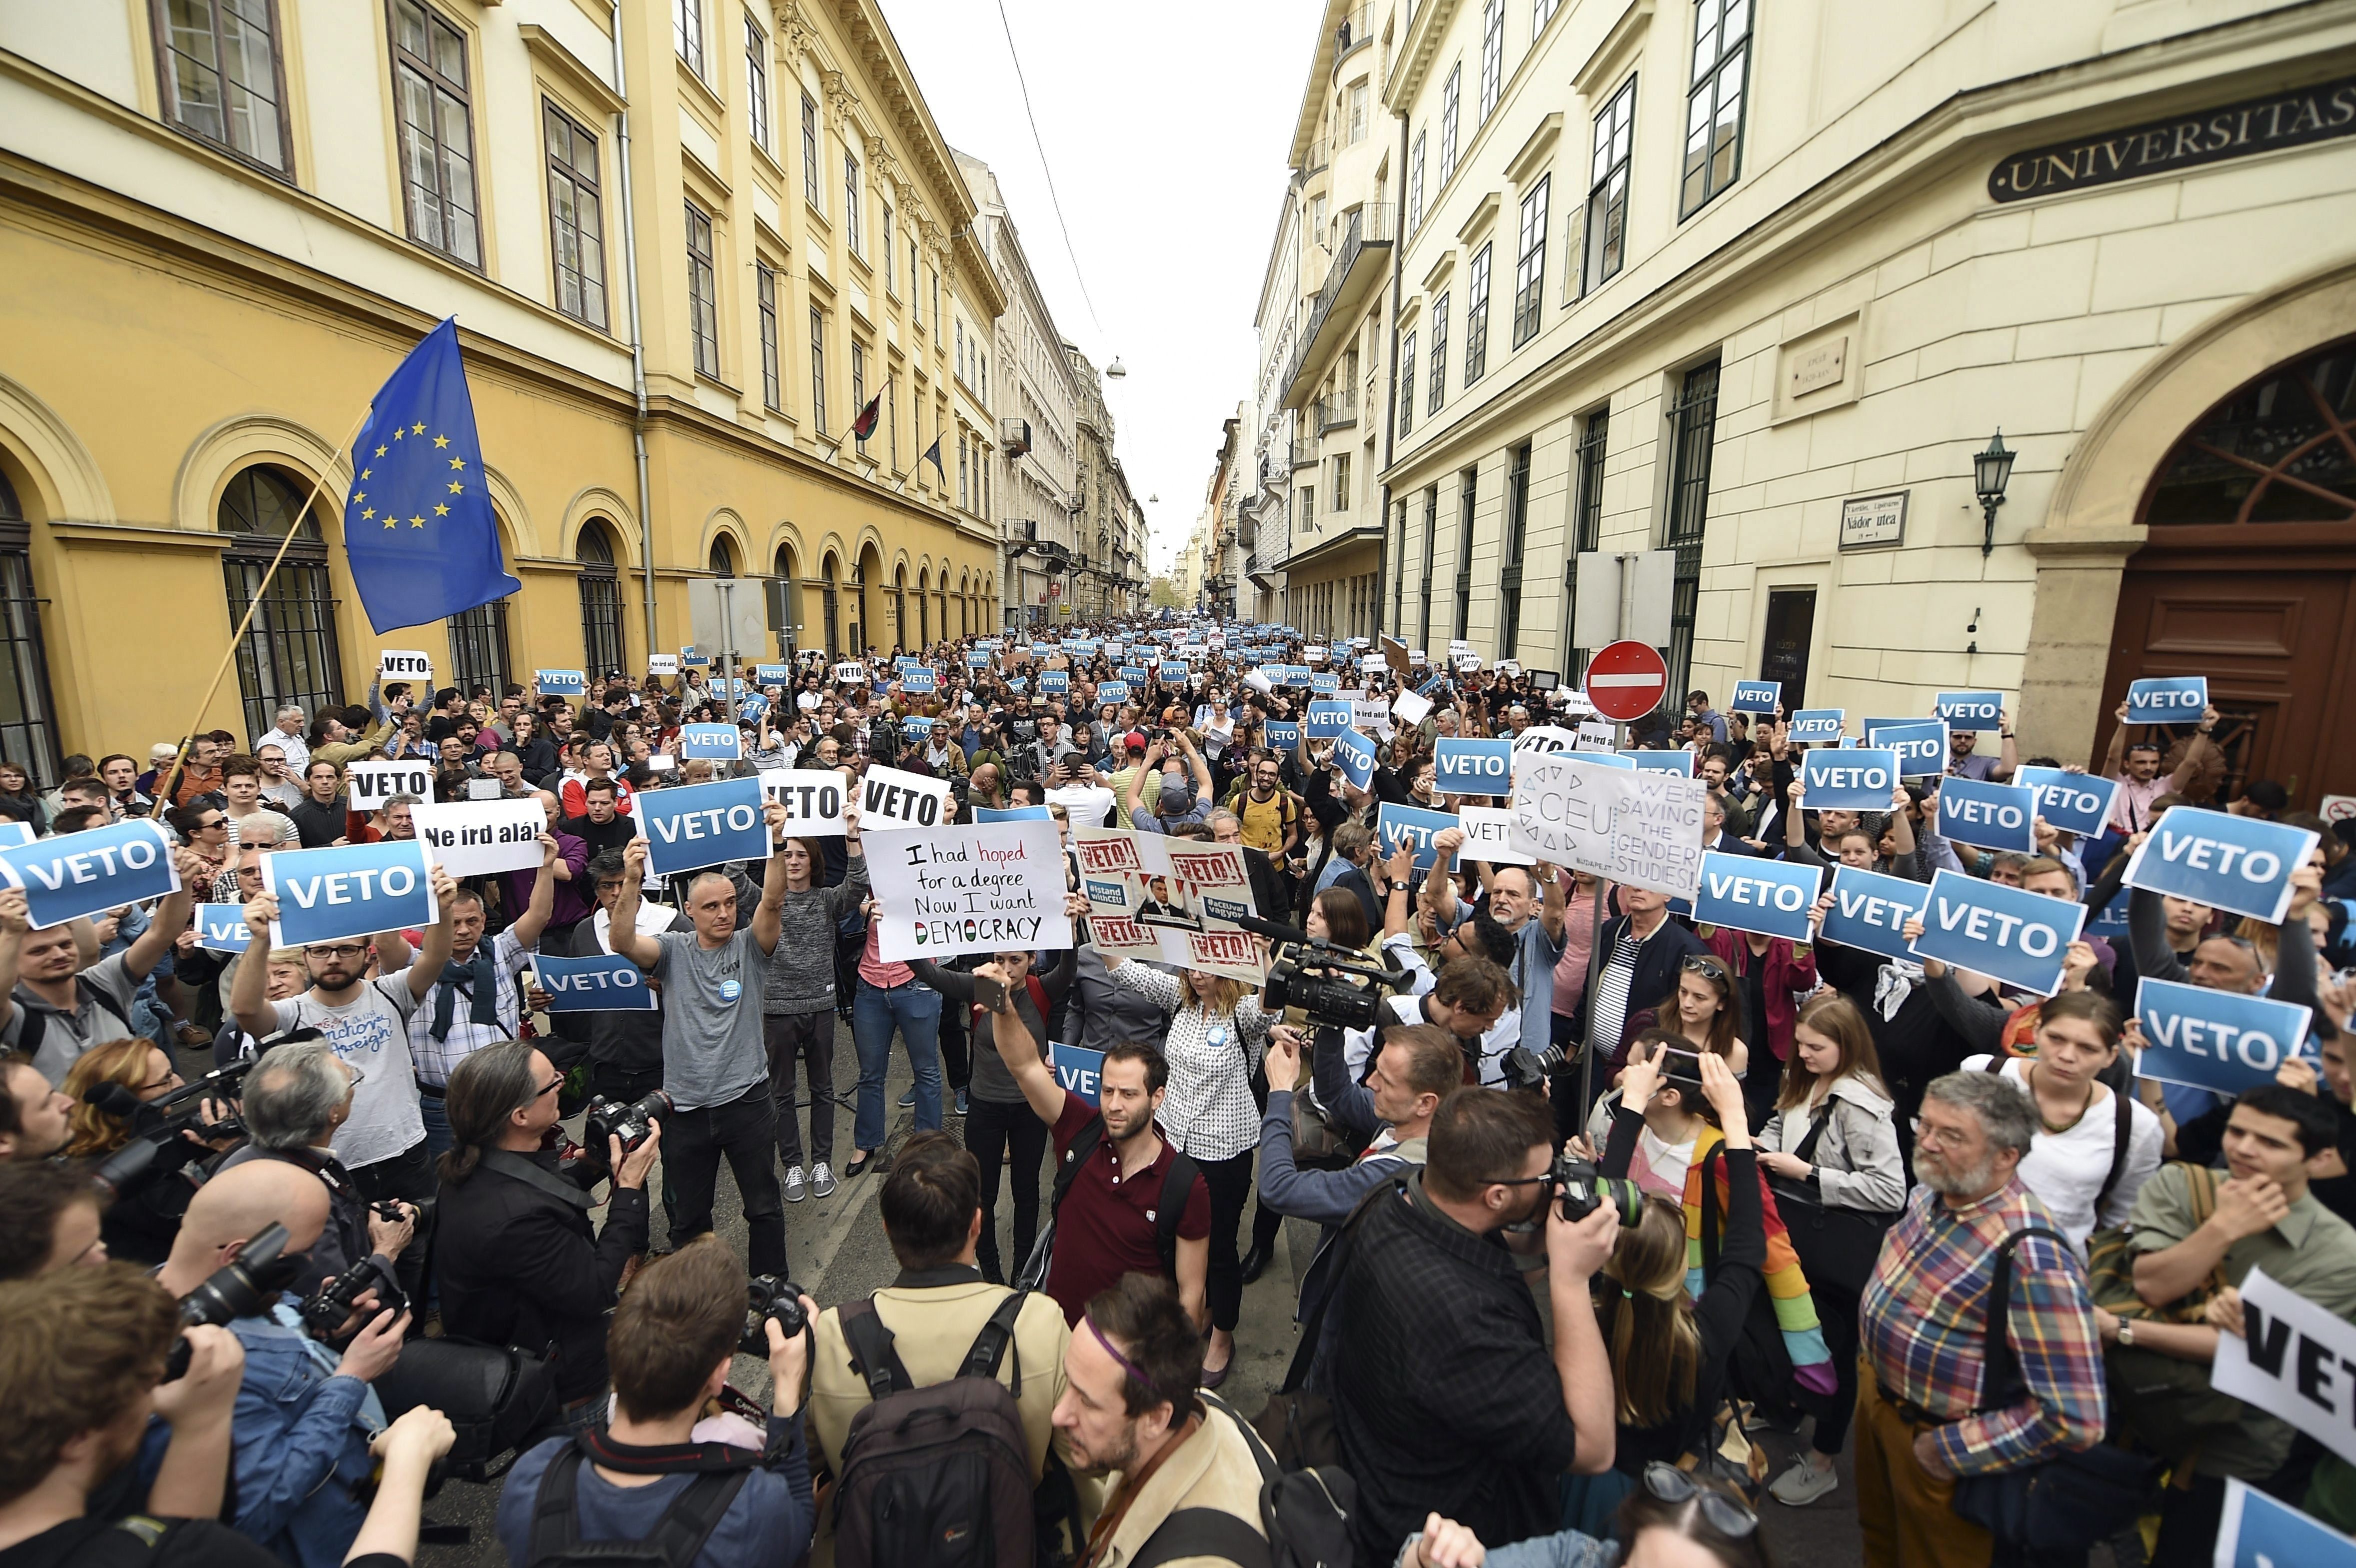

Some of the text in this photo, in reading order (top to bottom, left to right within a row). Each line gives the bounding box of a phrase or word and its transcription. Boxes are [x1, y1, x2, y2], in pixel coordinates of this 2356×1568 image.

[1848, 514, 1896, 530] Nádor utca
[384, 657, 427, 673] VETO
[760, 670, 784, 679] VETO
[838, 667, 862, 677] VETO
[1123, 672, 1144, 681] VETO
[1286, 671, 1307, 679] VETO
[542, 673, 579, 685] VETO
[905, 674, 931, 683] VETO
[1013, 682, 1024, 691] ETO
[1314, 679, 1335, 688] VETO
[1100, 687, 1124, 697] VETO
[1737, 689, 1774, 703] VETO
[2132, 690, 2201, 709] VETO
[1310, 711, 1349, 725] VETO
[1941, 702, 1997, 719] VETO
[902, 723, 930, 734] VETO
[1267, 730, 1296, 740] VETO
[1795, 719, 1838, 733] VETO
[688, 733, 734, 746] VETO
[1580, 733, 1591, 742] Ne
[1594, 735, 1606, 745] írd
[1338, 736, 1372, 771] VETO
[1441, 754, 1505, 776] VETO
[355, 771, 427, 797] VETO
[1809, 766, 1888, 790] VETO
[767, 786, 839, 819] ETO
[865, 779, 939, 826] VETO
[1638, 779, 1707, 803] WE'RE
[2026, 782, 2101, 814] VETO
[1539, 791, 1612, 835] CEU
[1619, 797, 1699, 826] SAVING
[1944, 795, 2024, 830] VETO
[424, 822, 540, 847] Ne írd alá!
[652, 804, 756, 844] VETO
[1385, 820, 1443, 850] VET
[1465, 822, 1510, 842] VET
[1639, 822, 1672, 840] THE
[905, 839, 1028, 873] I had hoped
[1081, 837, 1135, 868] VETO!
[1617, 834, 1696, 867] GENDER
[2162, 830, 2282, 884] VETO
[25, 839, 156, 891] VETO
[1175, 852, 1238, 883] VETO!
[1577, 857, 1613, 872] BUDAPEST
[1616, 856, 1695, 891] STUDIES!
[286, 865, 415, 909] VETO
[917, 868, 1024, 898] for a degree
[1090, 885, 1121, 896] #Istand
[1708, 872, 1805, 912] VETO
[915, 888, 1037, 916] Now I want
[1091, 894, 1122, 903] withCEU
[1207, 899, 1244, 912] #aCEUval
[1839, 889, 1925, 932] VET
[209, 922, 252, 943] VE
[915, 915, 1042, 946] DEMOCRACY
[1937, 896, 2059, 958] VETO
[1193, 933, 1251, 961] VETO!
[545, 969, 638, 992] VETO
[2147, 1009, 2279, 1071] VETO
[1059, 1065, 1100, 1095] VE
